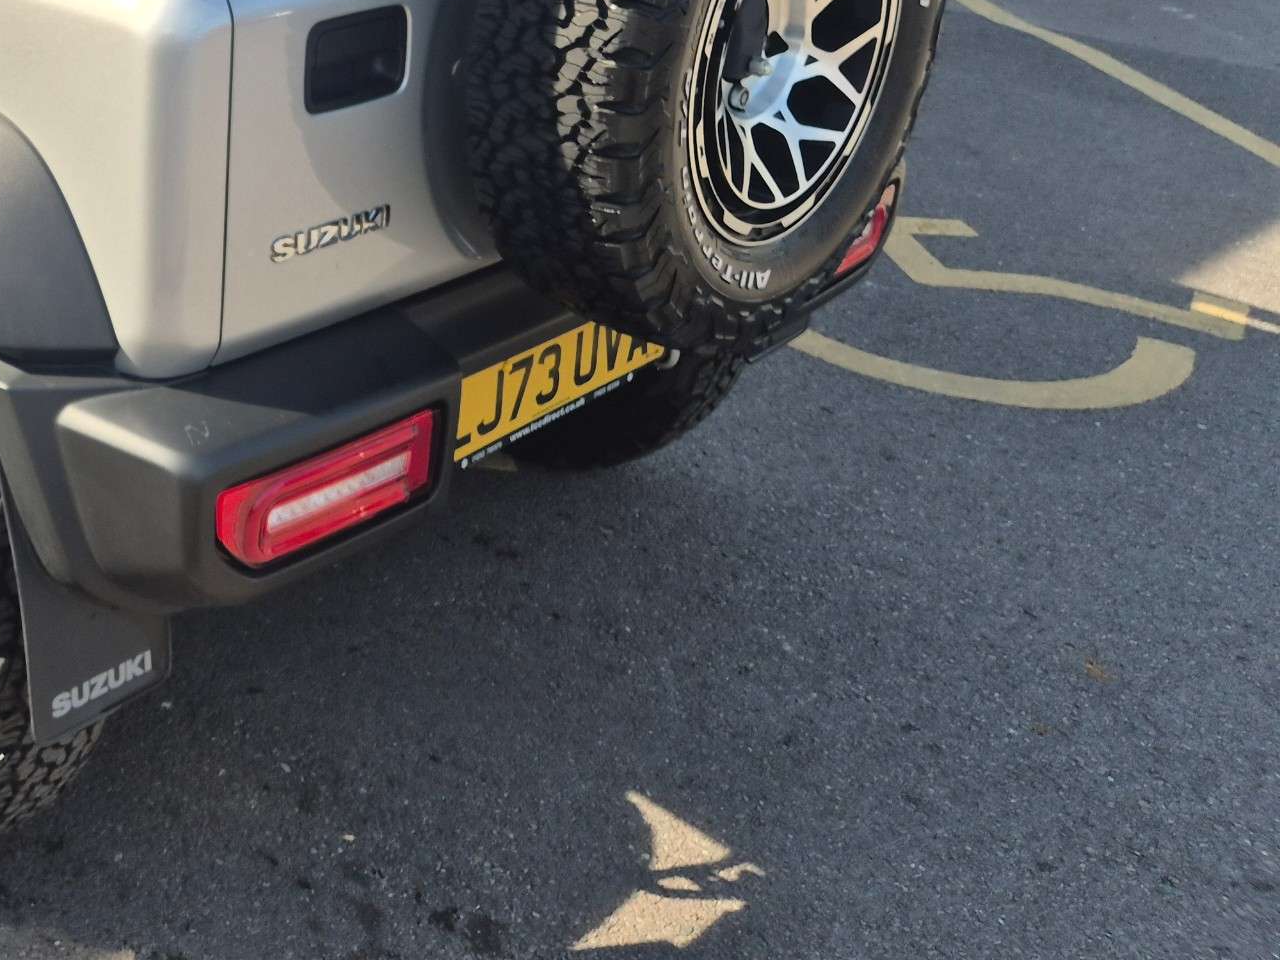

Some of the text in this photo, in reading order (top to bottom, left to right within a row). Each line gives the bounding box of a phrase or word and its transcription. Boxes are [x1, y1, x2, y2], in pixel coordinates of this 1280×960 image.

[270, 203, 391, 263] SUZUKI
[477, 343, 562, 436] J73
[51, 648, 153, 719] SUZUKI
